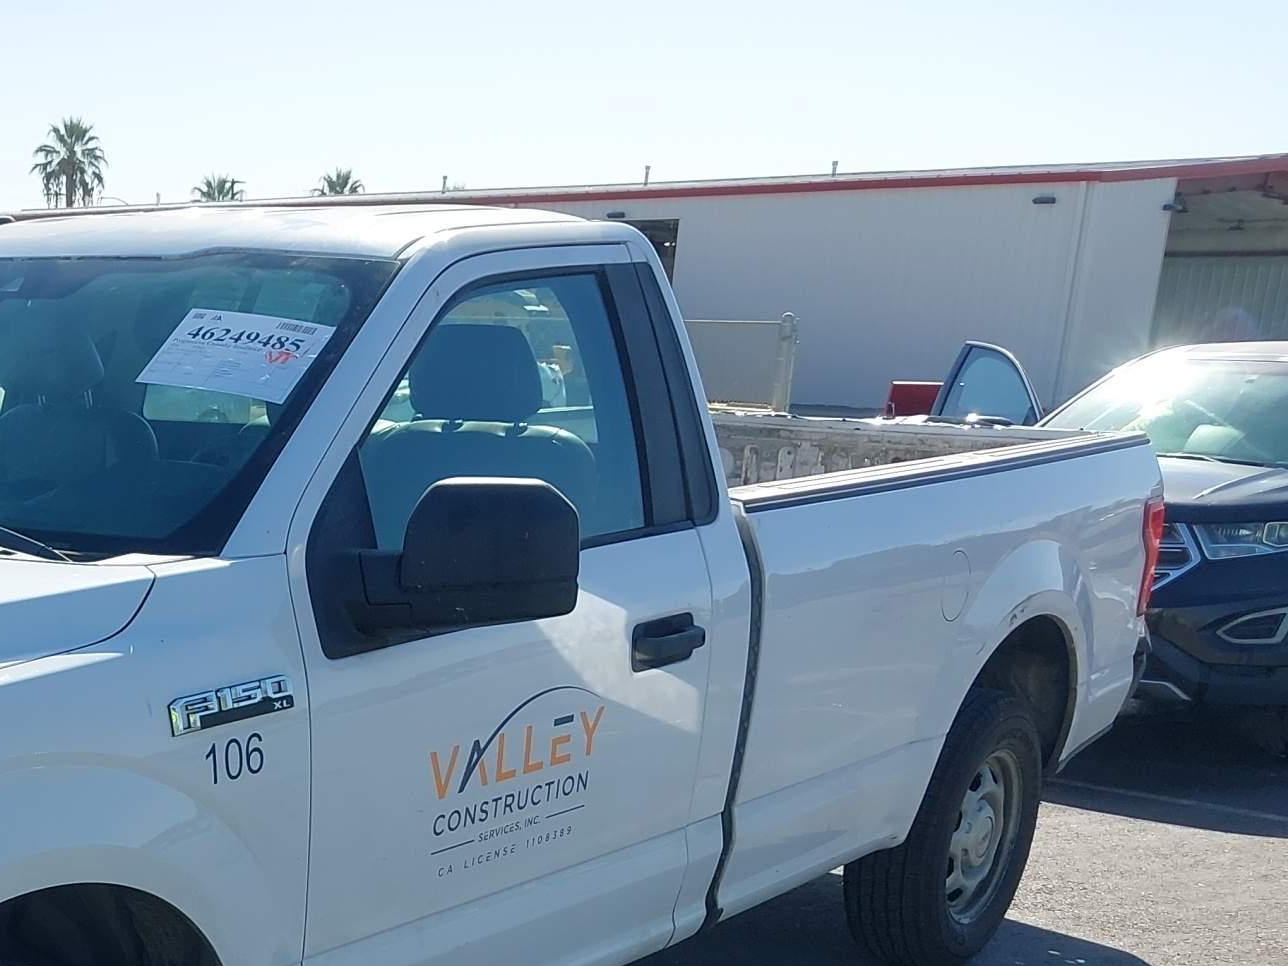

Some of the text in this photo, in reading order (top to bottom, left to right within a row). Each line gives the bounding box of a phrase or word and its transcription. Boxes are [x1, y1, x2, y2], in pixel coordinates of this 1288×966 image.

[187, 326, 305, 352] 46249485
[273, 699, 291, 710] XL
[205, 732, 264, 784] 106
[429, 705, 605, 800] VALLEY
[433, 770, 589, 836] CONSTRUCTION
[478, 815, 541, 843] SERVICES, INC.
[438, 864, 453, 877] CA
[463, 844, 516, 869] LICENSE
